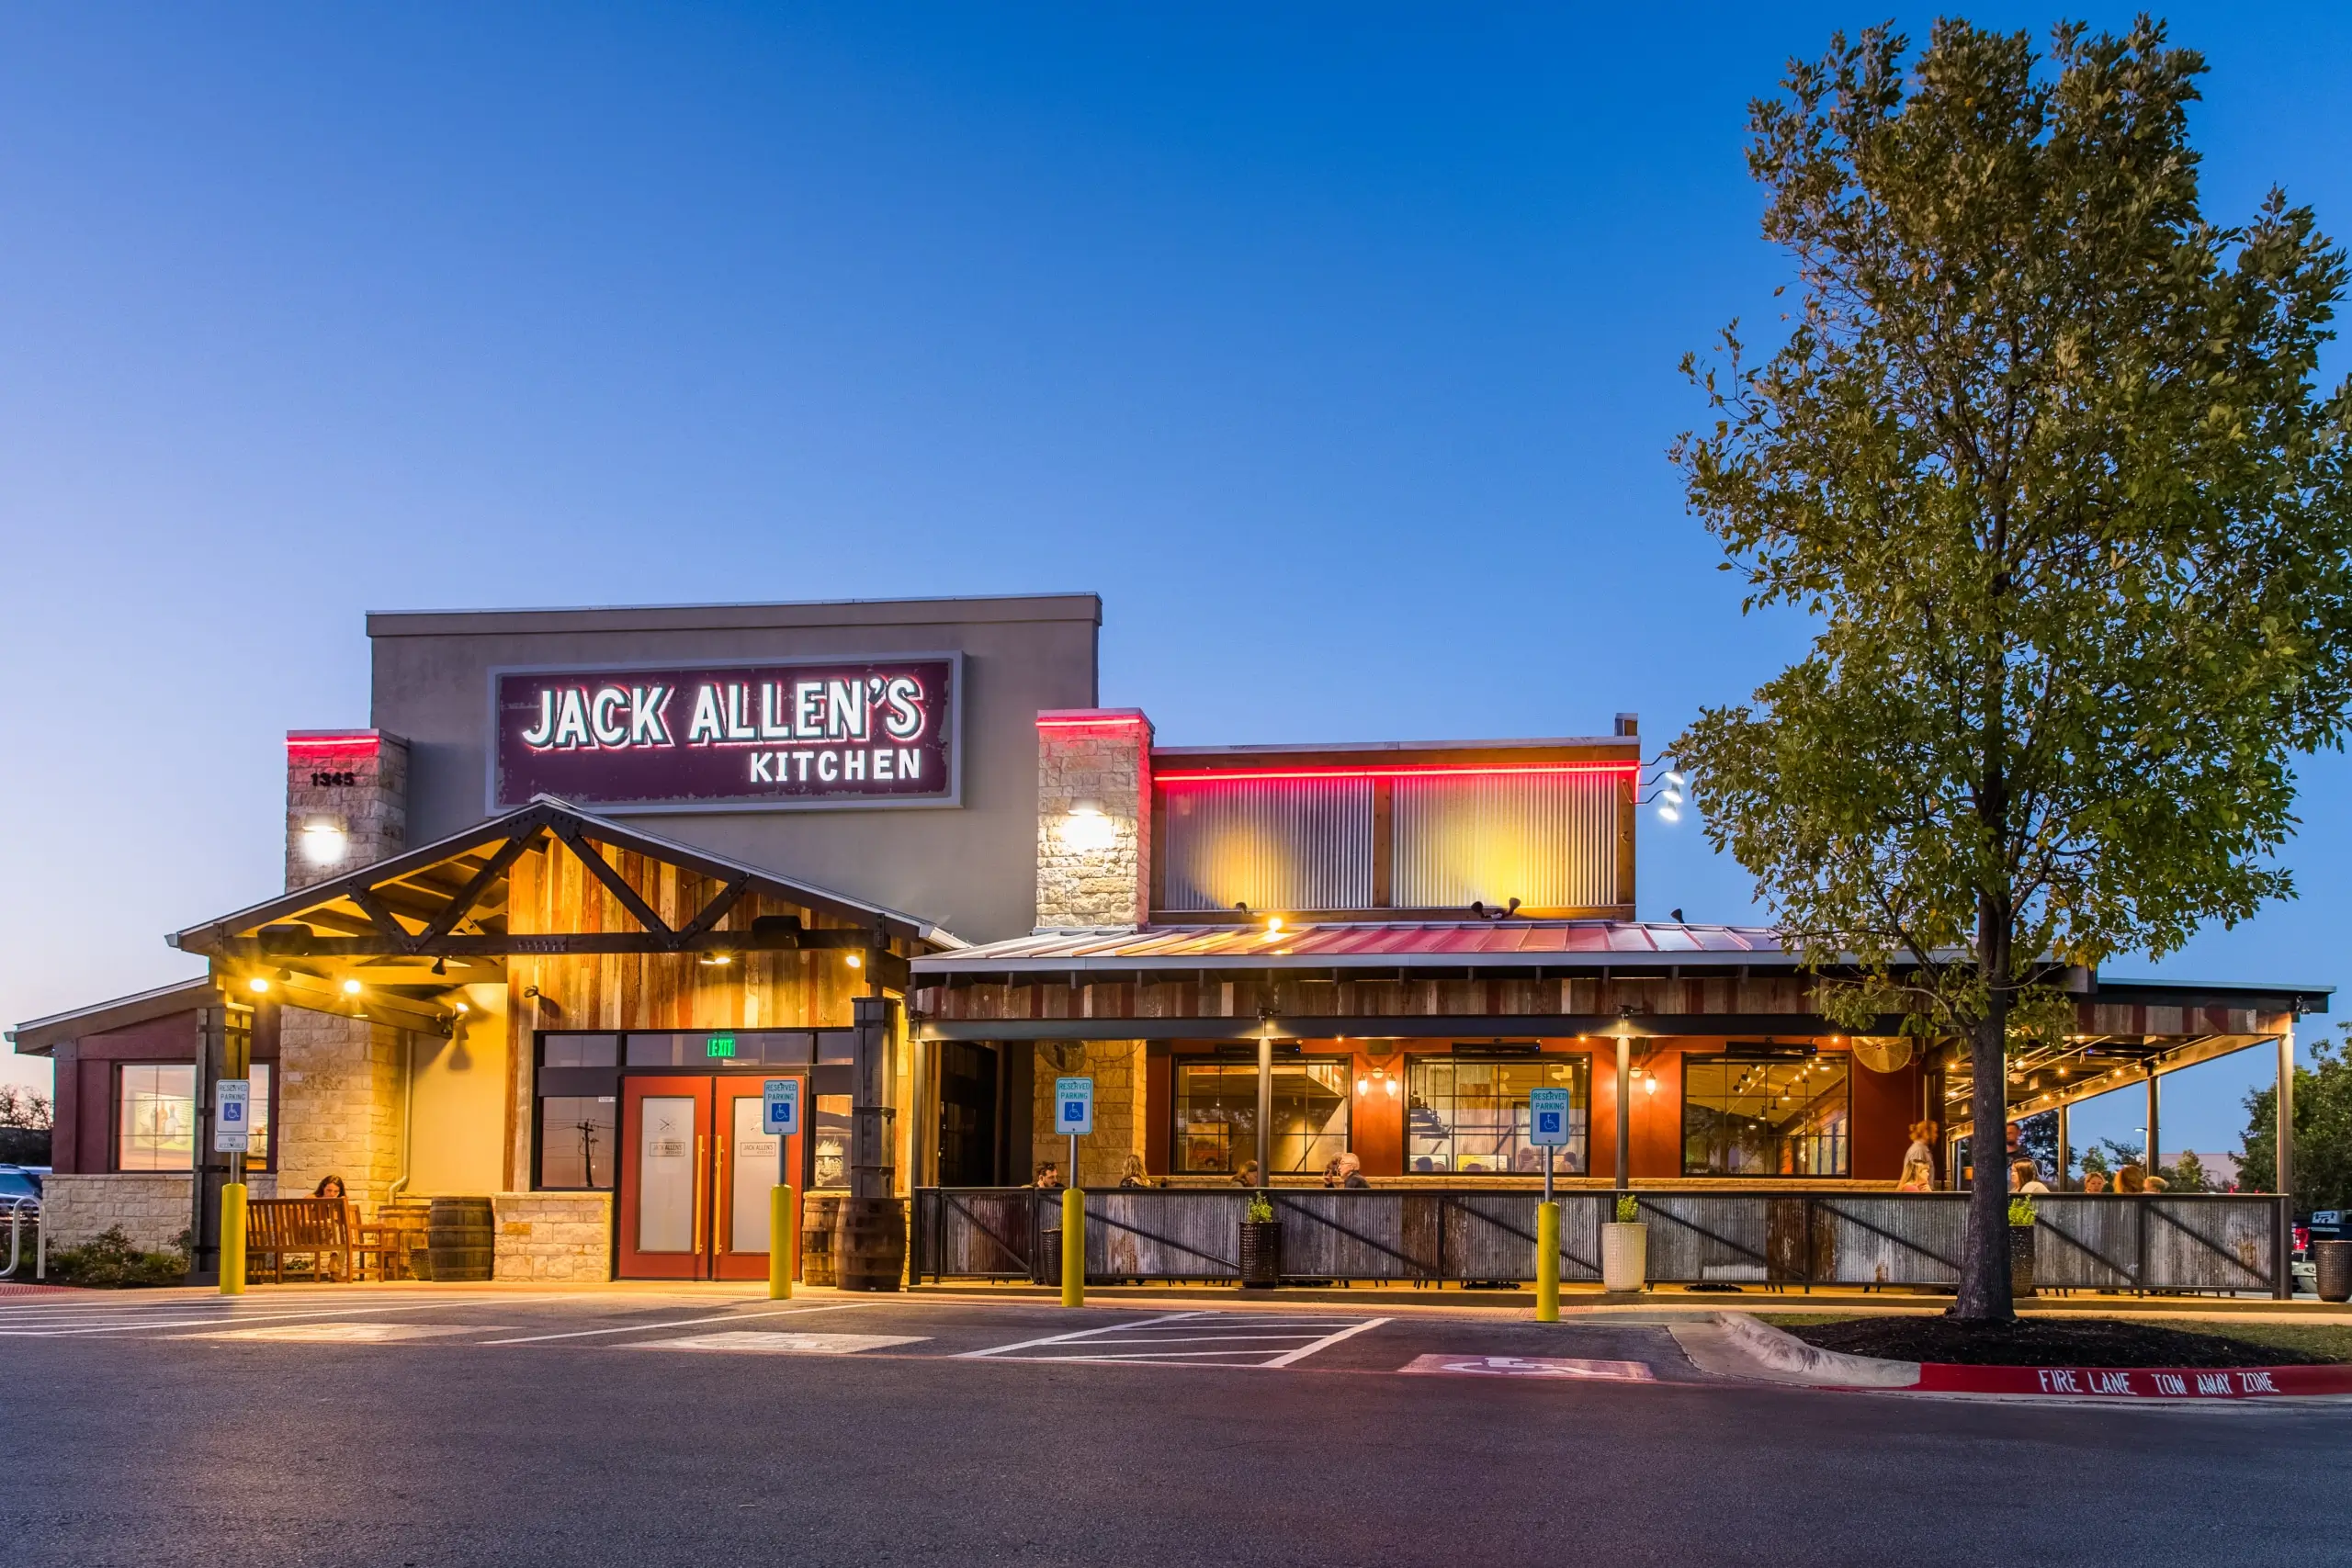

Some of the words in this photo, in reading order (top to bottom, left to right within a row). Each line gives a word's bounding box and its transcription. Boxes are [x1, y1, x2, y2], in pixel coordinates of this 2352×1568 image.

[522, 685, 673, 749] JACK
[688, 677, 924, 745] ALLEN'S
[749, 748, 922, 782] KITCHEN
[311, 772, 355, 786] 1345
[712, 1039, 732, 1056] EXIT
[2038, 1370, 2083, 1393] FIRE
[2086, 1371, 2138, 1394] LANE
[2151, 1373, 2188, 1394] TOW
[2196, 1373, 2233, 1394] AWAY
[2236, 1372, 2280, 1393] ZONE
